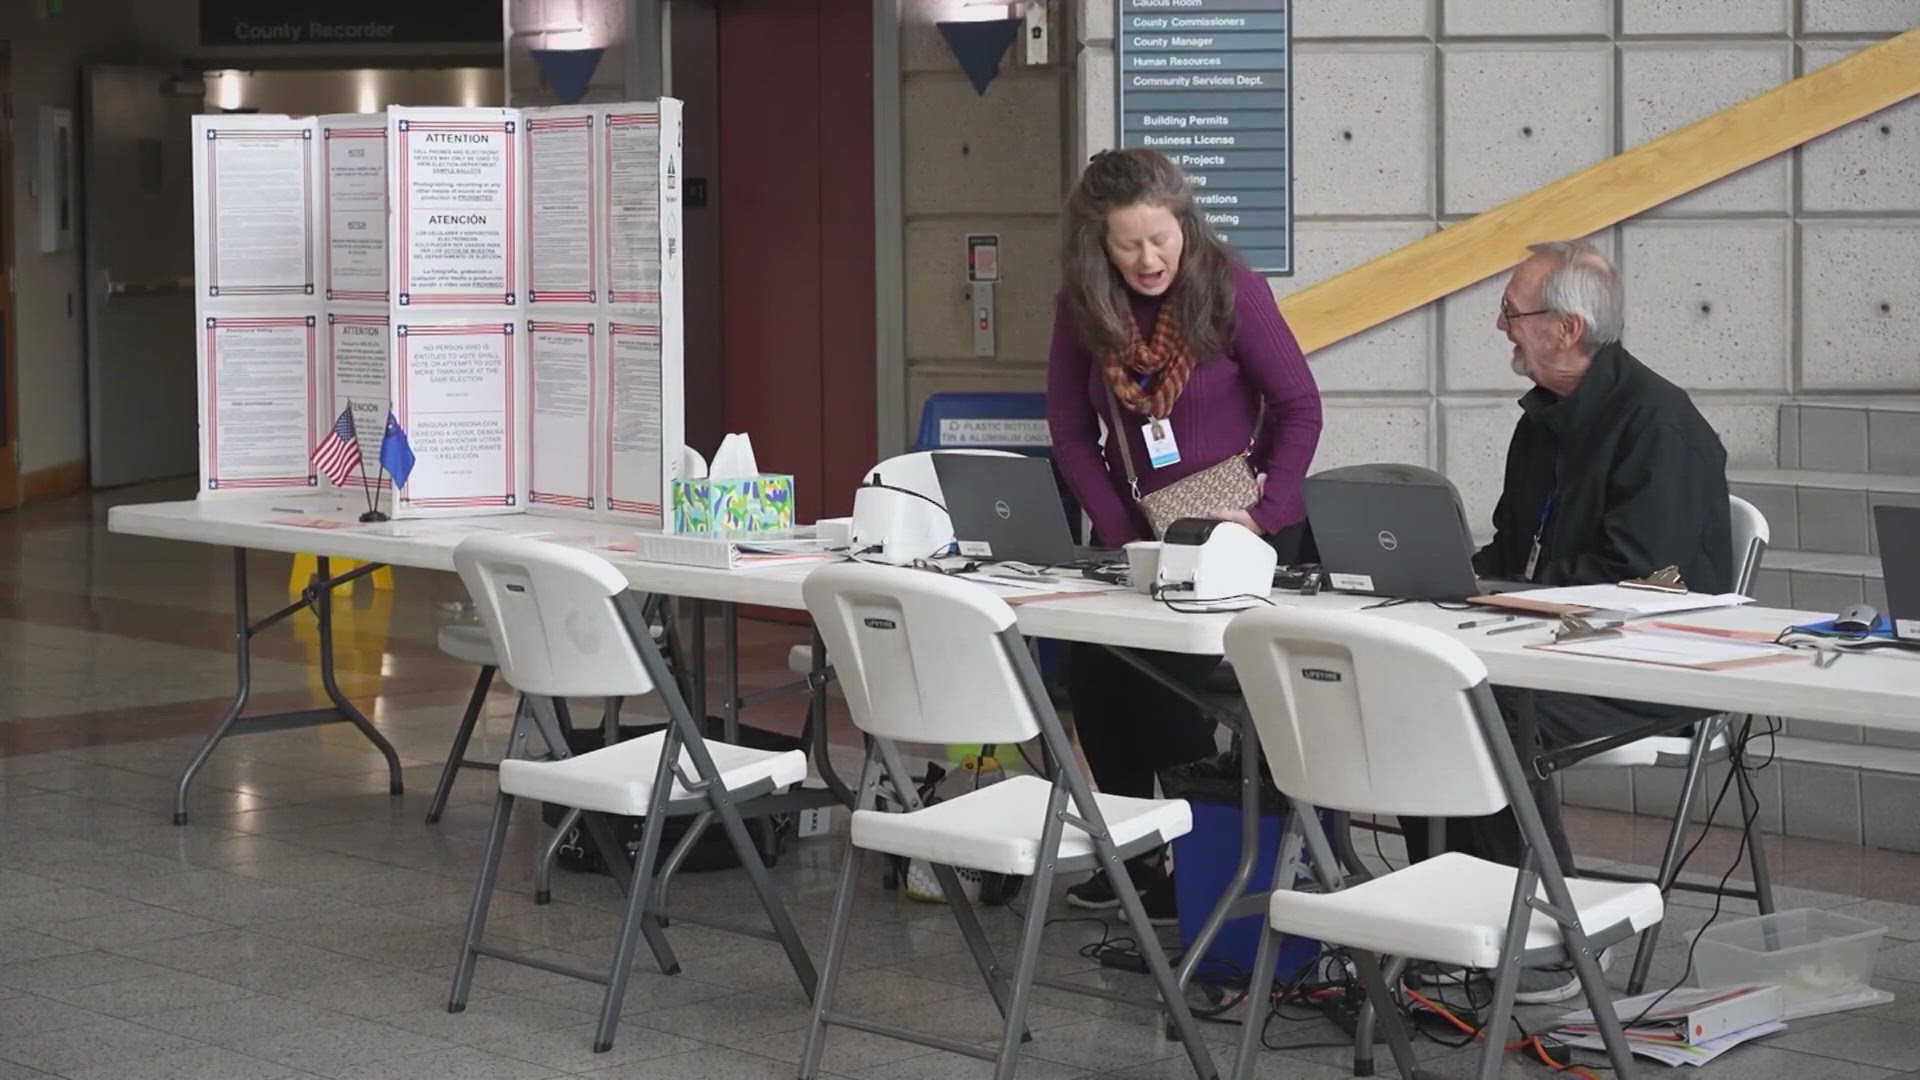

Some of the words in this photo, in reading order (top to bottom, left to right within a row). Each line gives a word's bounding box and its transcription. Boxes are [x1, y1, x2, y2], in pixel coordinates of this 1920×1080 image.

[1133, 17, 1168, 28] County
[1171, 17, 1246, 27] Commissioners
[235, 22, 300, 41] County
[309, 21, 395, 38] Recorder
[1133, 37, 1168, 48] County
[1171, 37, 1214, 48] Manager
[1133, 57, 1167, 66] Human
[1169, 57, 1222, 66] Resources
[1133, 76, 1190, 87] Community
[1192, 75, 1235, 86] Services
[1237, 75, 1263, 86] Dept.
[1143, 115, 1187, 127] Building
[1189, 115, 1229, 126] Permits
[425, 133, 489, 143] ATTENTION
[1143, 135, 1191, 145] Business
[1194, 135, 1235, 145] License
[1182, 155, 1225, 166] Projects
[1193, 194, 1238, 204] rvations
[428, 213, 487, 225] ATENCIÓN
